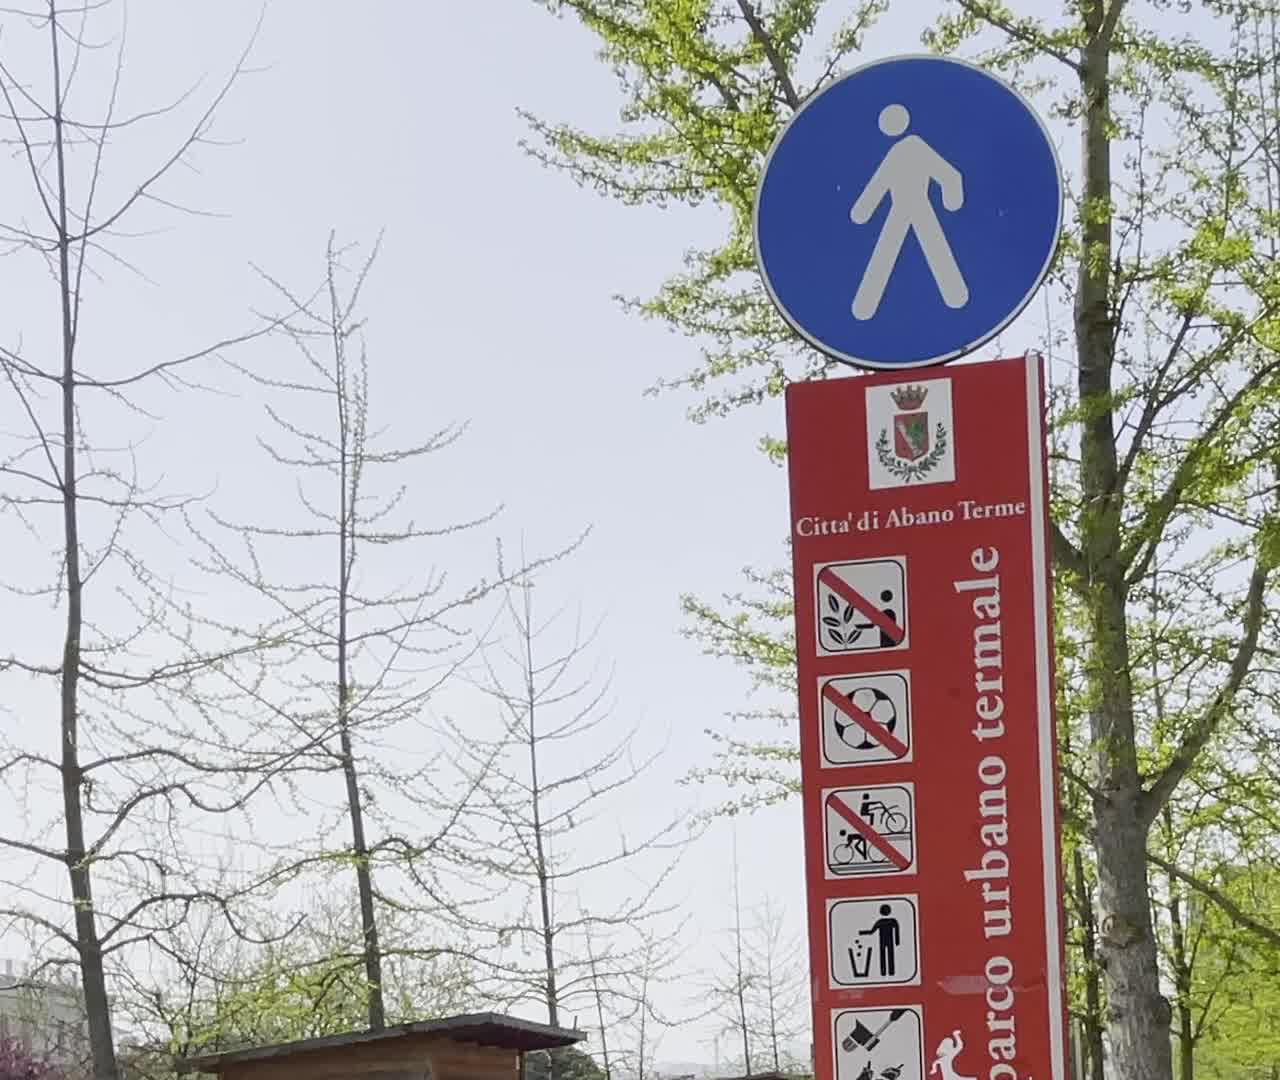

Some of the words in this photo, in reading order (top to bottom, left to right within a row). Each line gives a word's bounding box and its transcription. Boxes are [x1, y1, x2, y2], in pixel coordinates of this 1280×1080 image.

[857, 509, 879, 532] di
[887, 503, 954, 528] Abano
[959, 499, 1025, 521] Terme
[953, 545, 1005, 742] termale
[963, 755, 1014, 939] urbano
